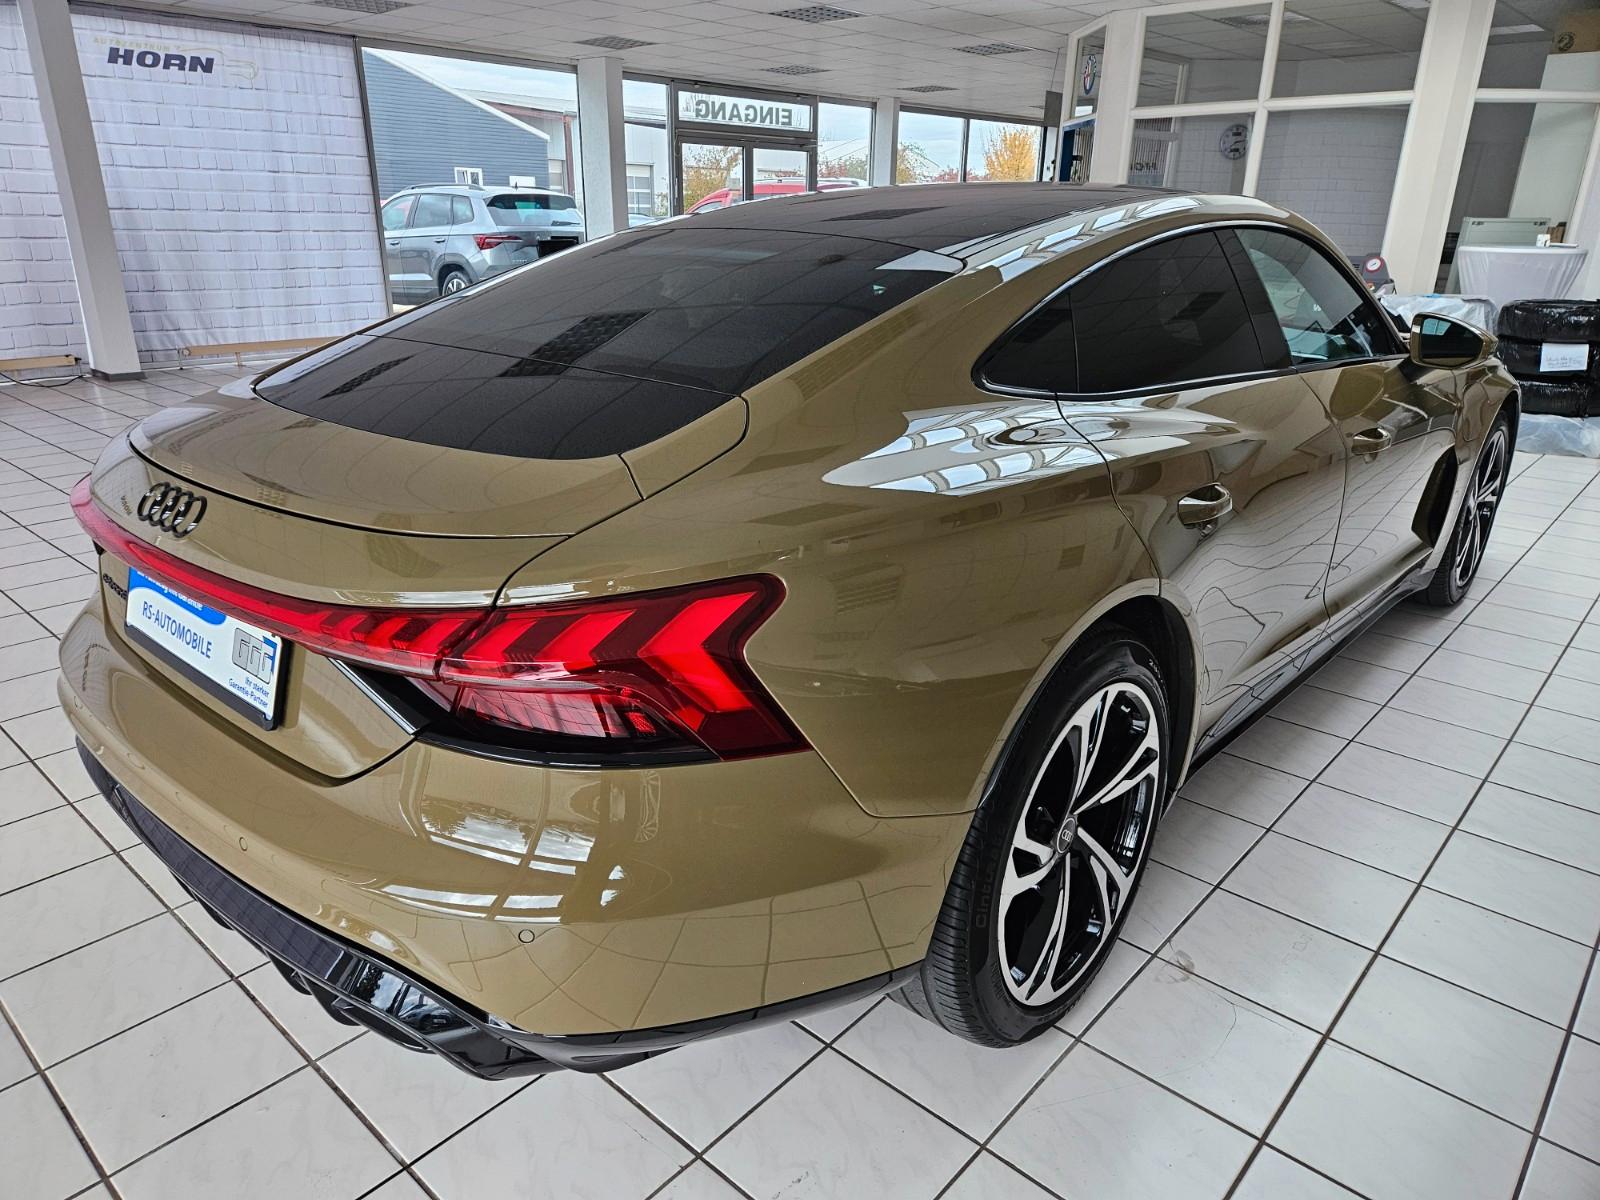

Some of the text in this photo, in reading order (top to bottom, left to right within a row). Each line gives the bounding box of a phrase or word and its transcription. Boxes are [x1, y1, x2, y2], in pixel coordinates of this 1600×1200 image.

[107, 47, 215, 74] HORN
[142, 600, 213, 659] RS-AUTOMOBILE
[228, 678, 269, 708] Garantie-Partner
[252, 682, 270, 698] starker
